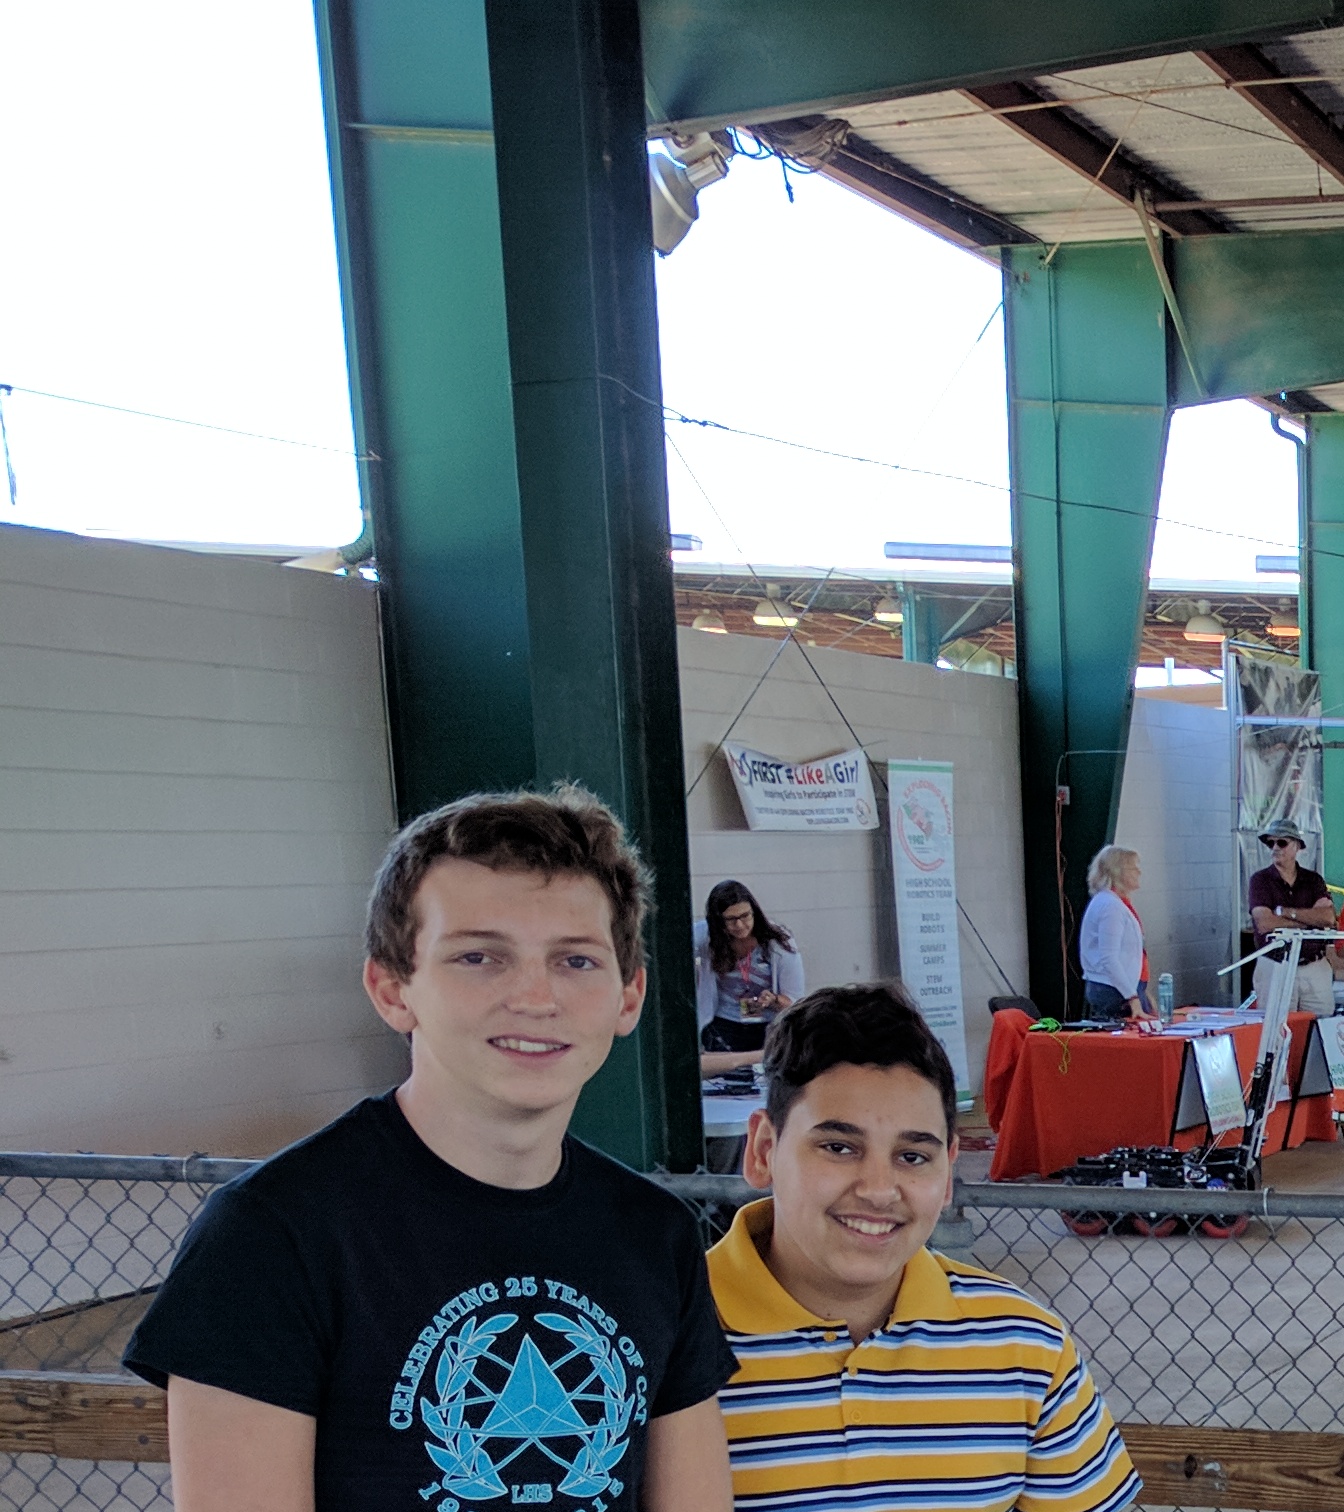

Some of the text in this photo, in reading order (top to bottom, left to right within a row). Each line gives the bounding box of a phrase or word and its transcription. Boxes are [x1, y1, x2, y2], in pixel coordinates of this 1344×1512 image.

[751, 759, 784, 784] FIRST
[924, 878, 952, 888] SCHOOL
[389, 1277, 648, 1430] CELEBRATING 25 YEARS OF CAT
[511, 1484, 553, 1503] LHS
